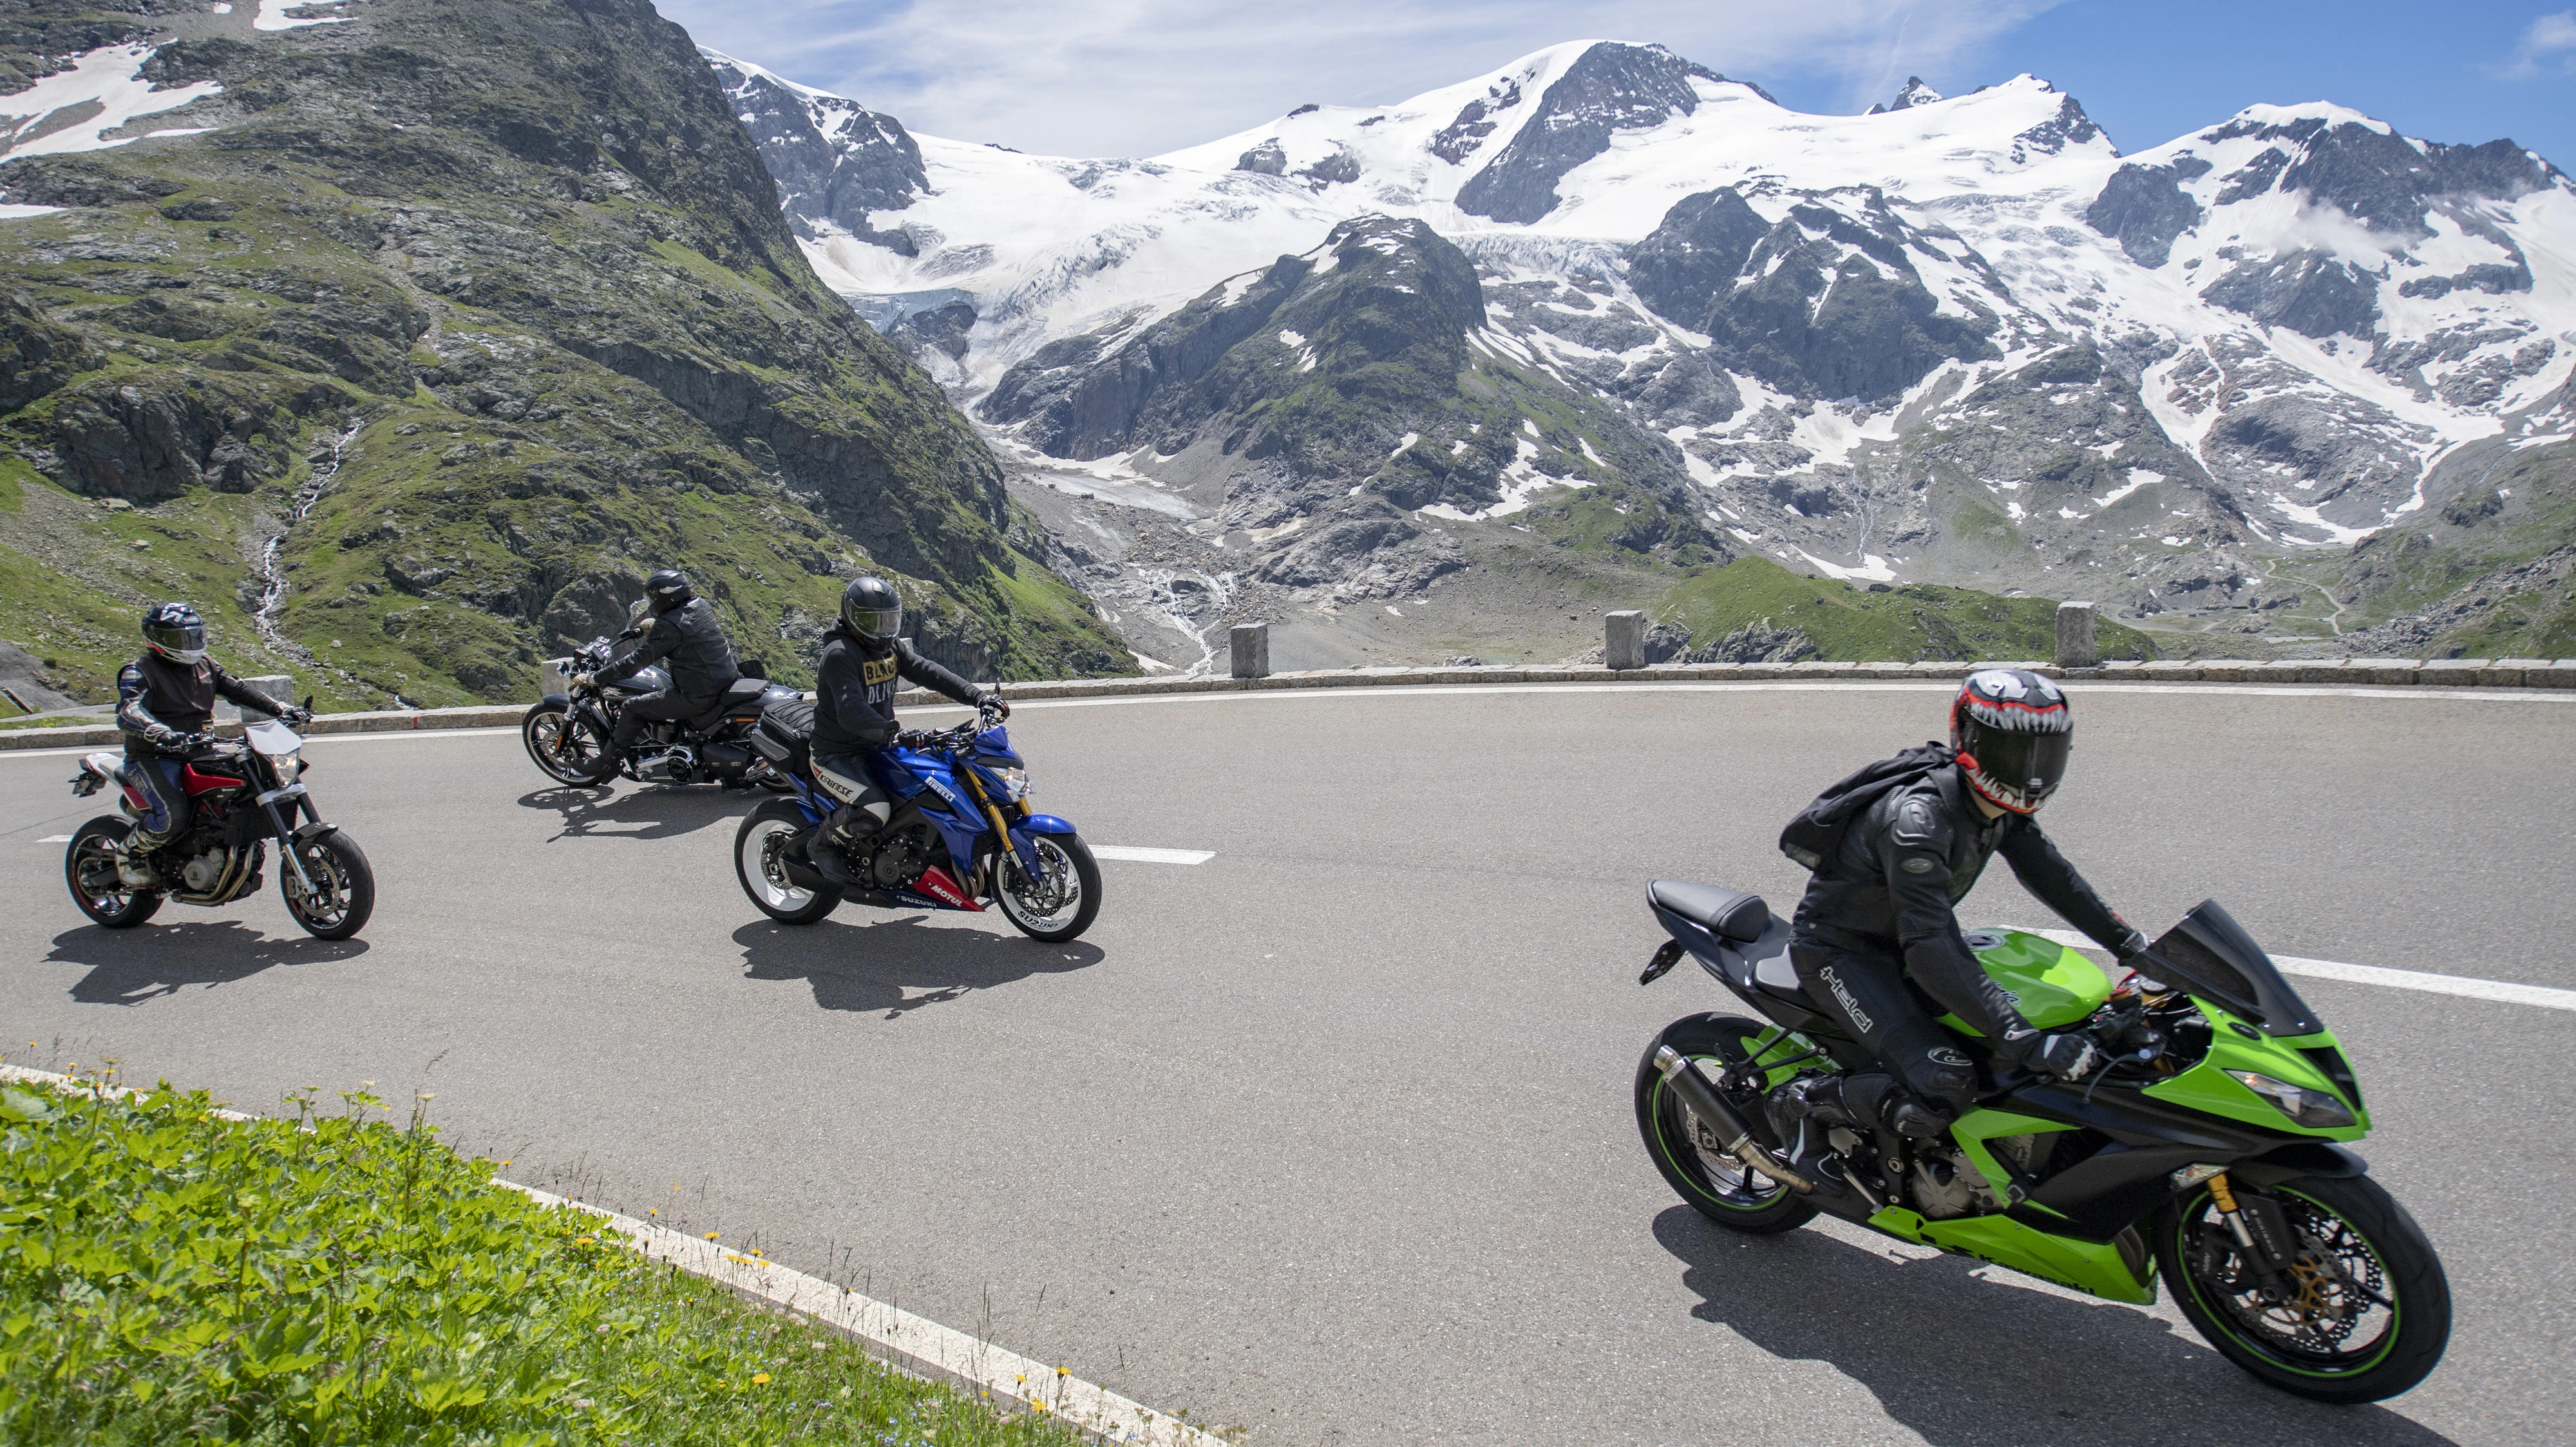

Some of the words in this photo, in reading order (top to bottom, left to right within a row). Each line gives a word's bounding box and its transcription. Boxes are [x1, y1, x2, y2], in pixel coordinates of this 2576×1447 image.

[865, 661, 895, 680] BLAC
[925, 775, 956, 802] PIRELLI
[900, 896, 937, 907] SUZUKI
[931, 885, 963, 907] MOTUL
[1018, 911, 1058, 928] SUZUKI
[1820, 966, 1874, 1034] Held
